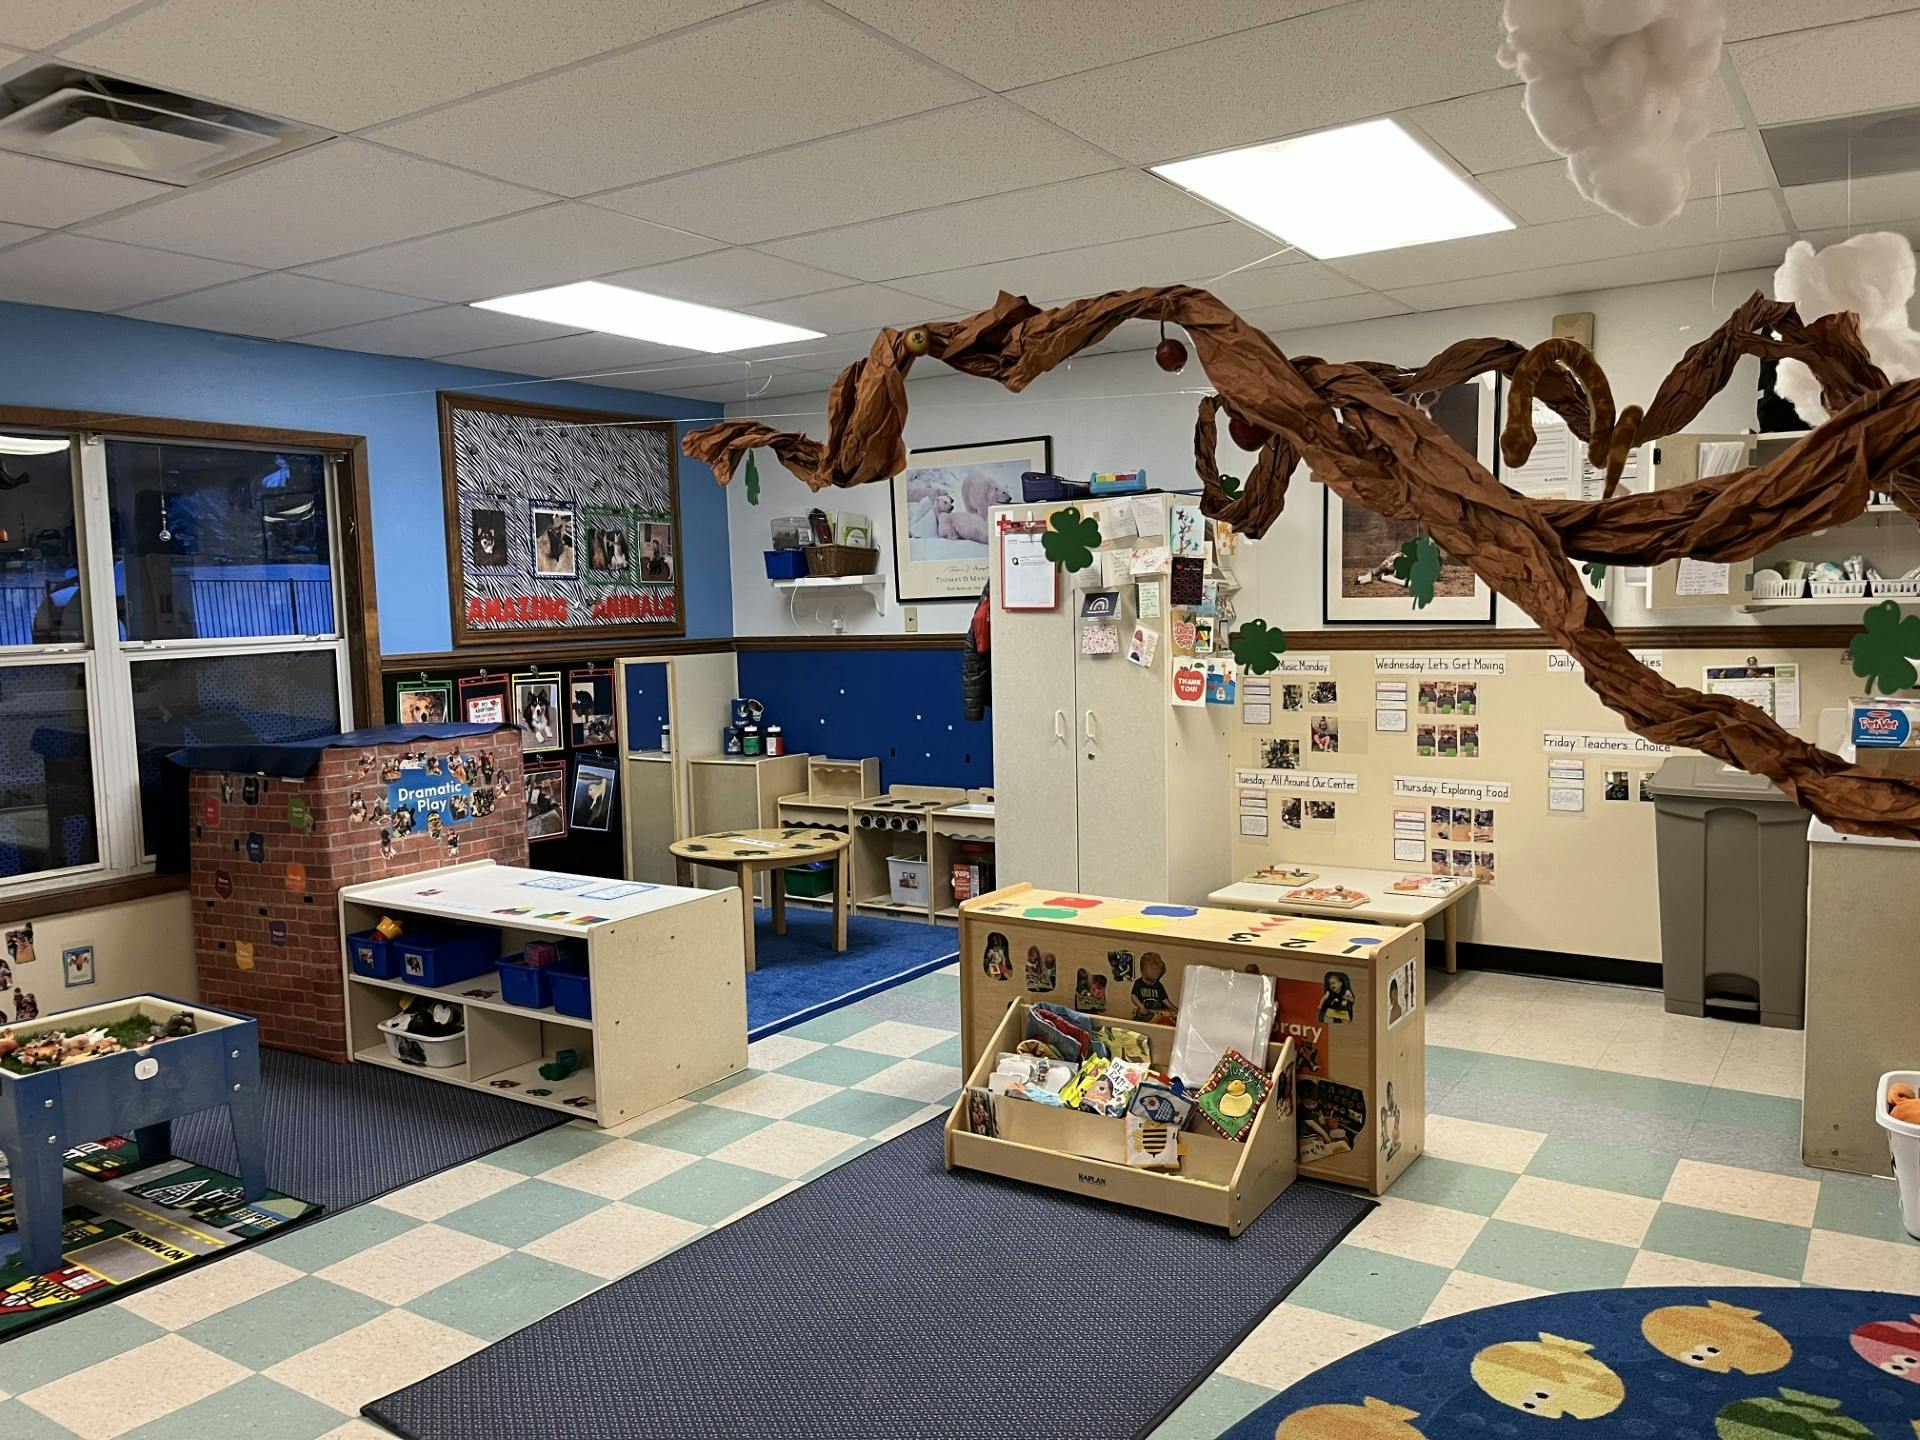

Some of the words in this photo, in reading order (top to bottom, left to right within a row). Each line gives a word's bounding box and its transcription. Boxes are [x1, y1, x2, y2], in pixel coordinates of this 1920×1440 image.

[467, 594, 568, 623] AMAZING
[592, 593, 675, 619] ANIMALS
[1278, 660, 1299, 671] Music
[1299, 660, 1328, 673] Monday
[1452, 658, 1471, 670] Get
[1474, 658, 1505, 675] Moving
[1548, 655, 1576, 671] Daily
[1178, 677, 1202, 686] THANK
[1180, 685, 1198, 693] YOU!
[1859, 717, 1878, 730] Pet
[1879, 718, 1898, 730] Vet
[1635, 738, 1671, 752] Choice
[1270, 774, 1282, 786] All
[1283, 775, 1310, 787] Around
[1312, 776, 1325, 788] Our
[1327, 778, 1355, 790] Center
[398, 781, 462, 801] Dramatic
[1441, 782, 1482, 800] Exploring
[1486, 785, 1509, 798] Food
[417, 799, 447, 812] Play
[1079, 1173, 1106, 1186] KAPLAN
[122, 1231, 168, 1253] PARKING
[166, 1249, 188, 1261] NO
